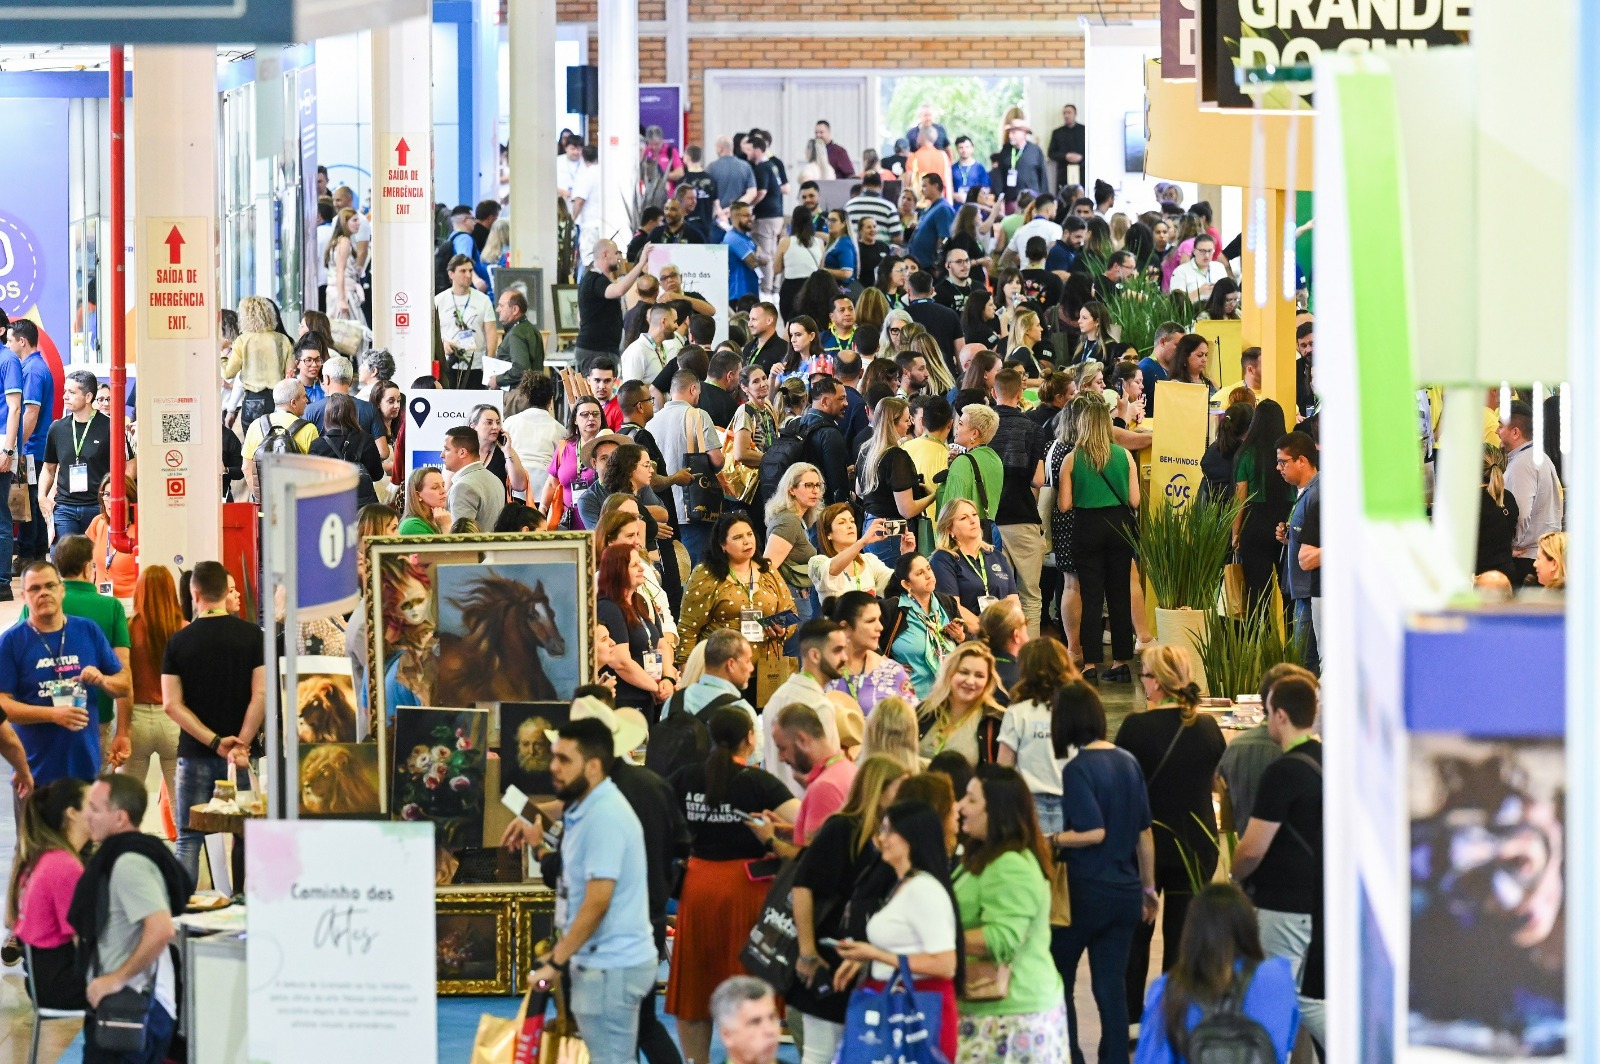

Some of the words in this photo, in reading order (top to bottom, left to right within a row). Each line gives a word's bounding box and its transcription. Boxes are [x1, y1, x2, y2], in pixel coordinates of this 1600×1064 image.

[388, 167, 408, 180] SAÍDA
[410, 170, 418, 180] DE
[382, 185, 424, 198] EMERGÊNCIA
[396, 204, 410, 214] EXIT
[156, 267, 183, 283] SAÍDA
[186, 269, 197, 283] DE
[150, 290, 204, 307] EMERGÊNCIA
[1160, 456, 1198, 466] BEM-VINDOS
[1165, 484, 1190, 498] CVC
